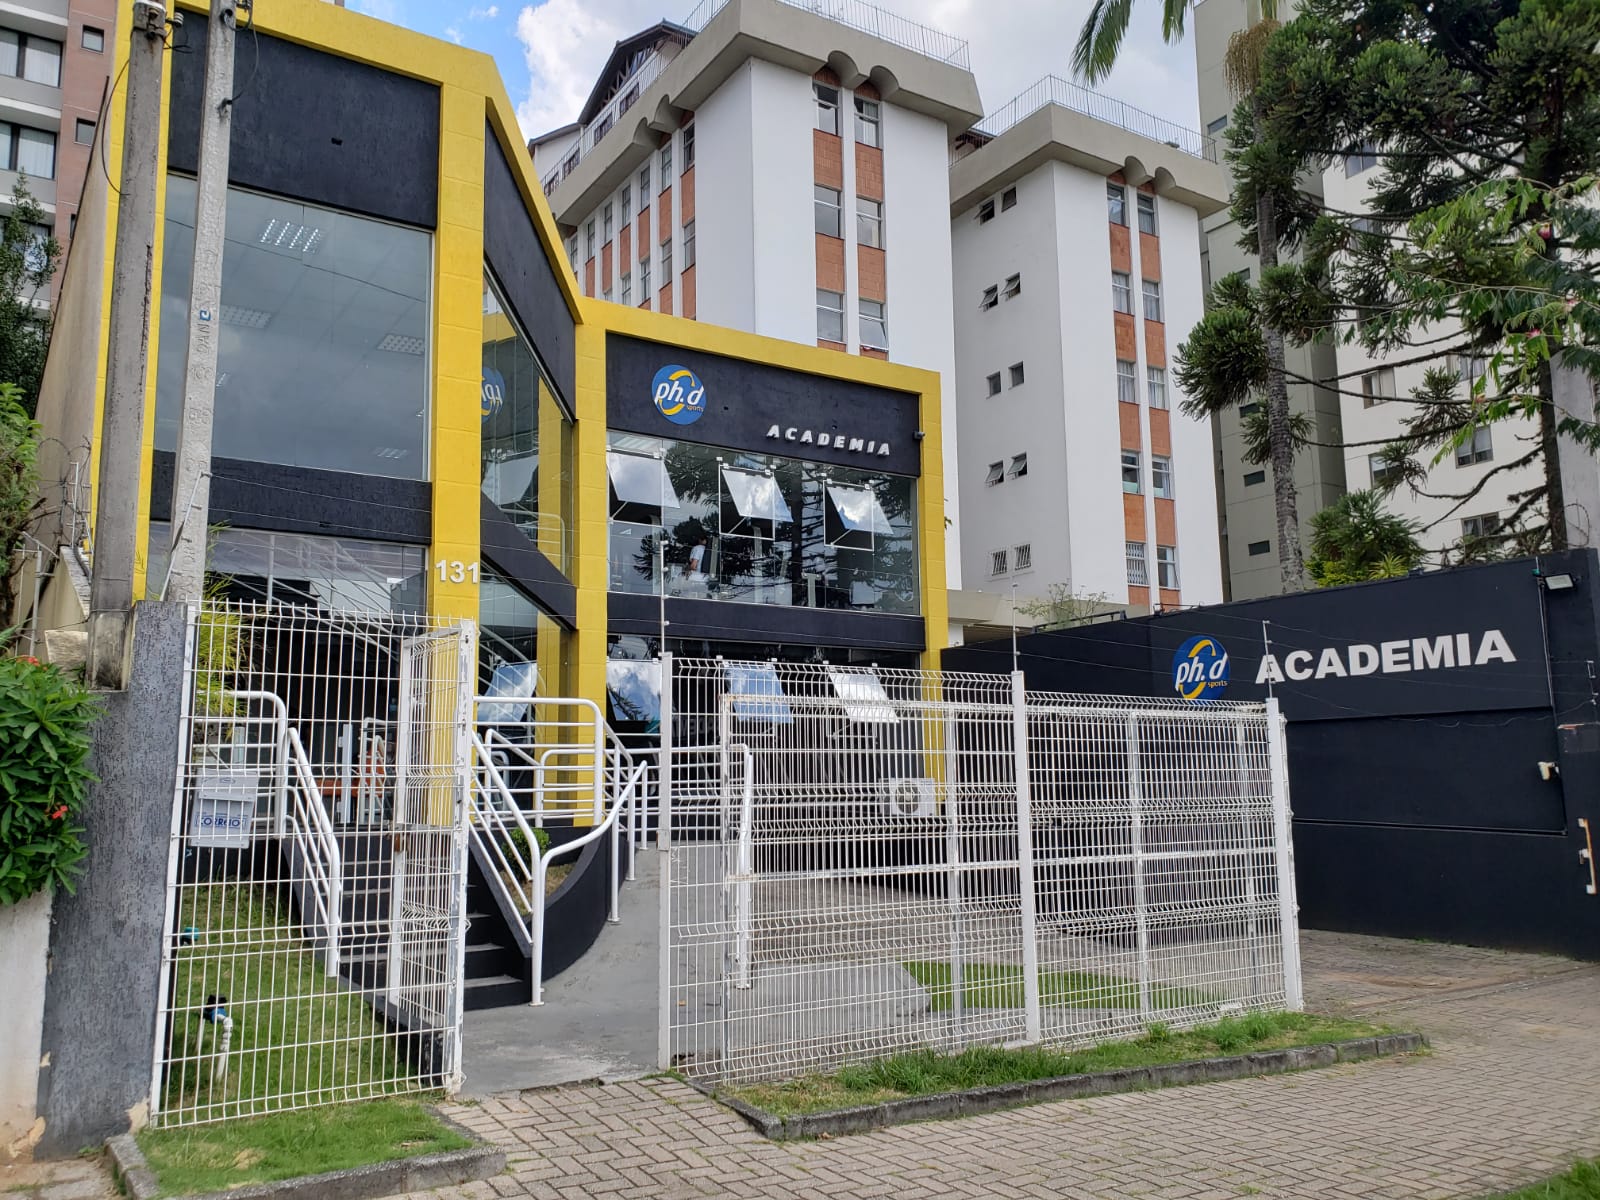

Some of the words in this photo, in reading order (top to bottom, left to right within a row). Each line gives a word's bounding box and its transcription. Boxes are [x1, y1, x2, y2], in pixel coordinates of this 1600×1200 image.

[654, 380, 705, 406] ph.d
[766, 424, 891, 457] ACADEMIA
[435, 559, 479, 584] 131
[1255, 629, 1517, 684] ACADEMIA
[1174, 651, 1228, 692] ph.d
[1207, 680, 1228, 689] sports
